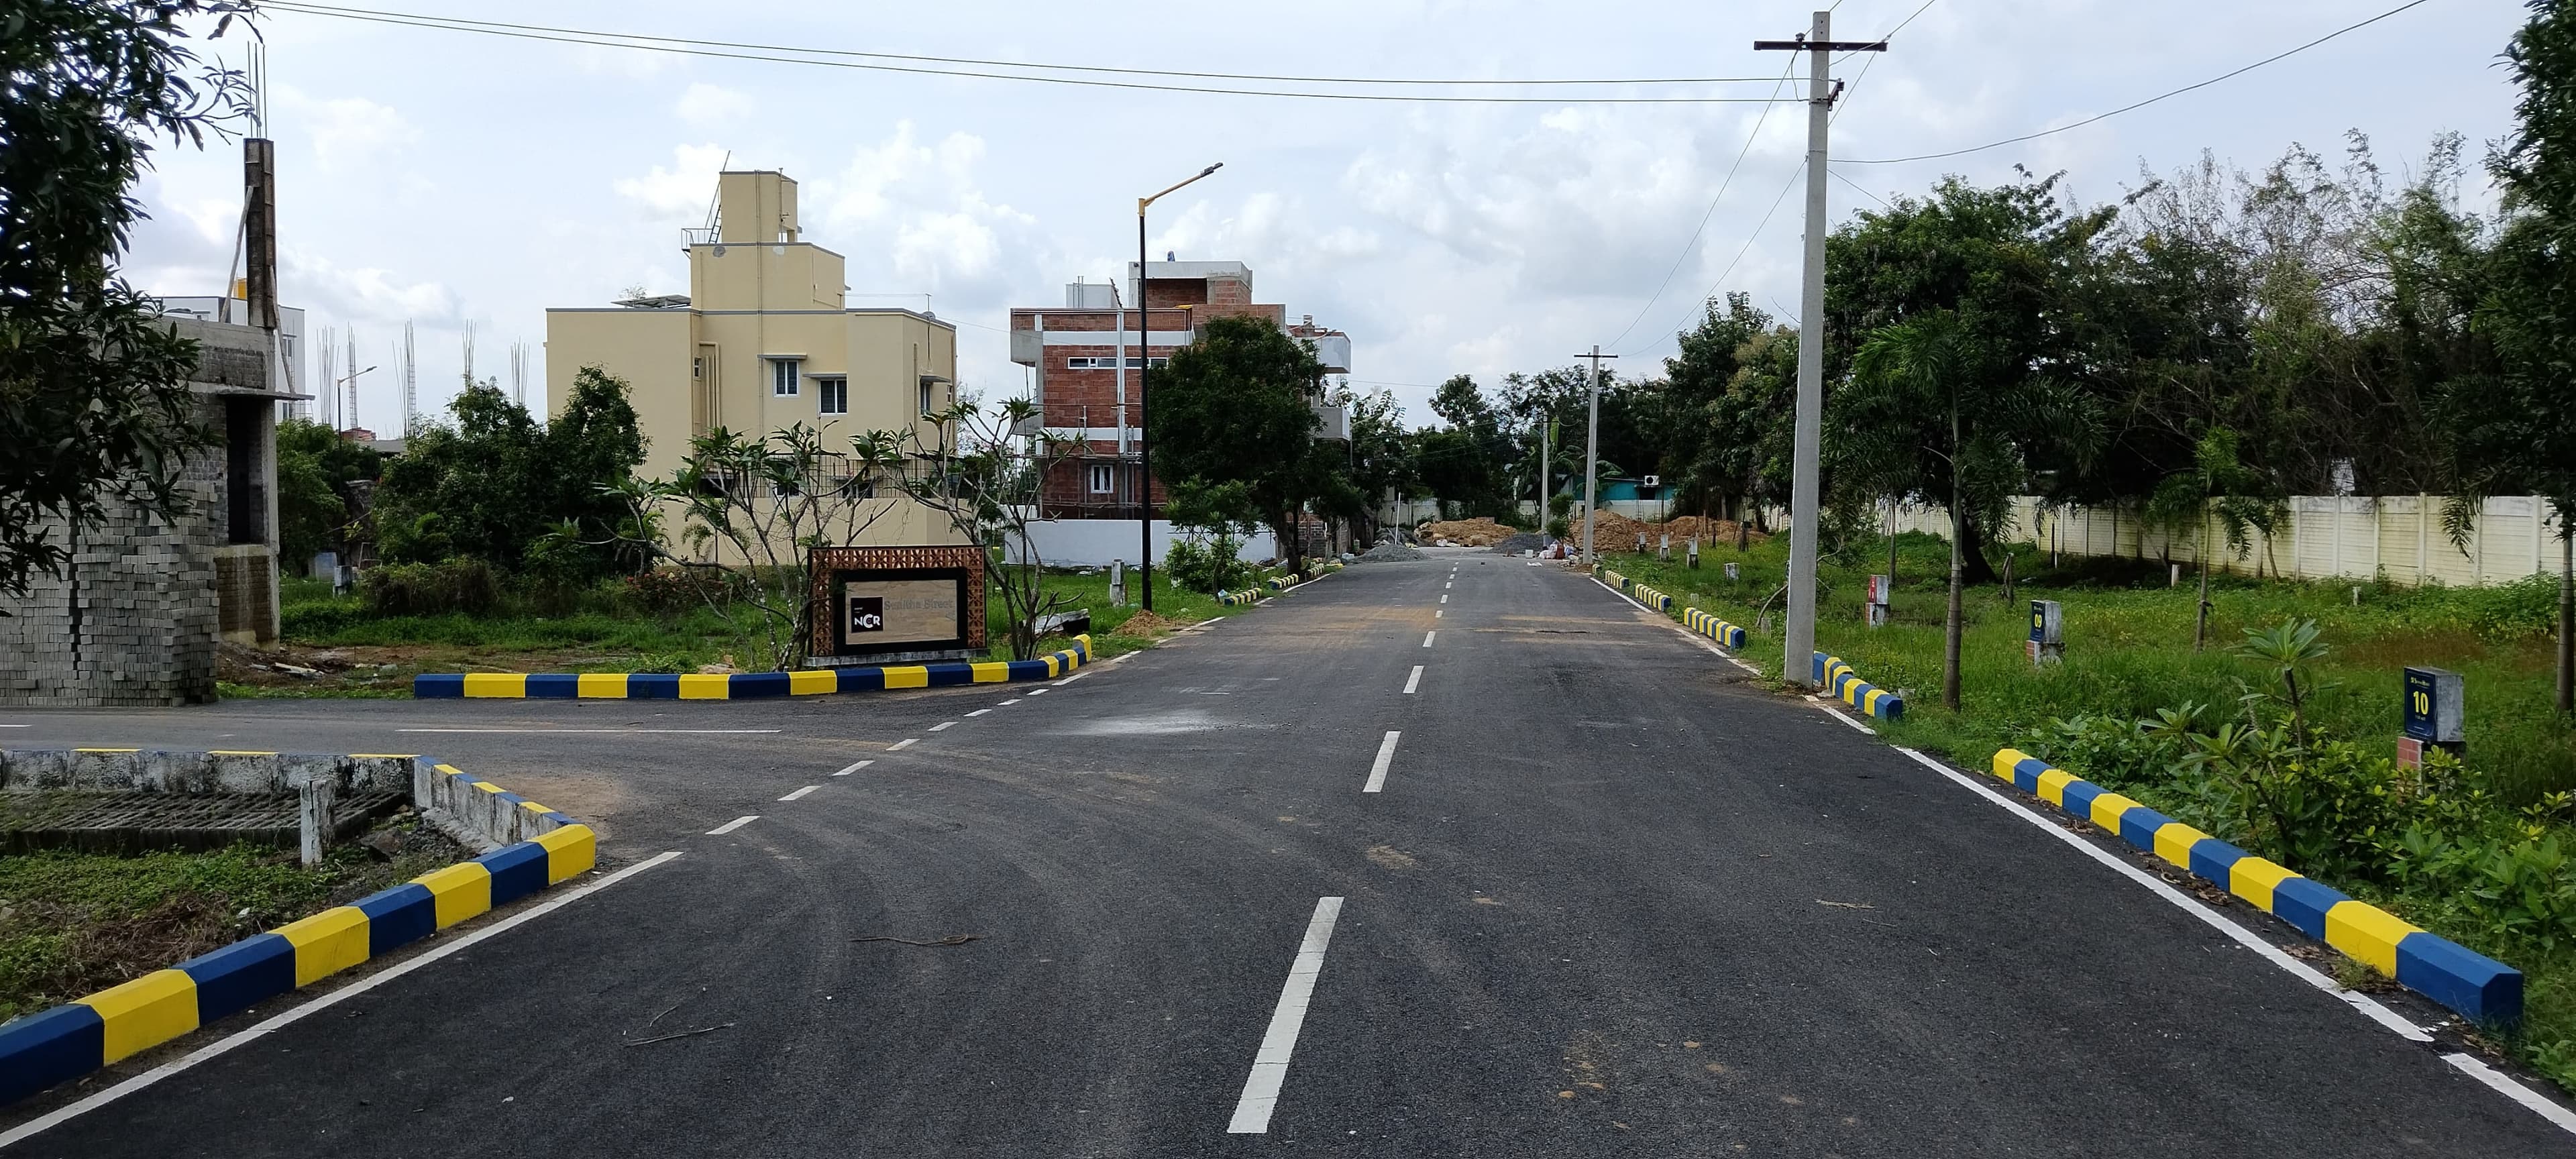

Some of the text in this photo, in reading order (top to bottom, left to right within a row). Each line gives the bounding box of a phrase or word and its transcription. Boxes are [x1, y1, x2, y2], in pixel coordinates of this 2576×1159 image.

[854, 613, 881, 628] NCR
[2035, 613, 2042, 628] 09
[2413, 691, 2428, 715] 10
